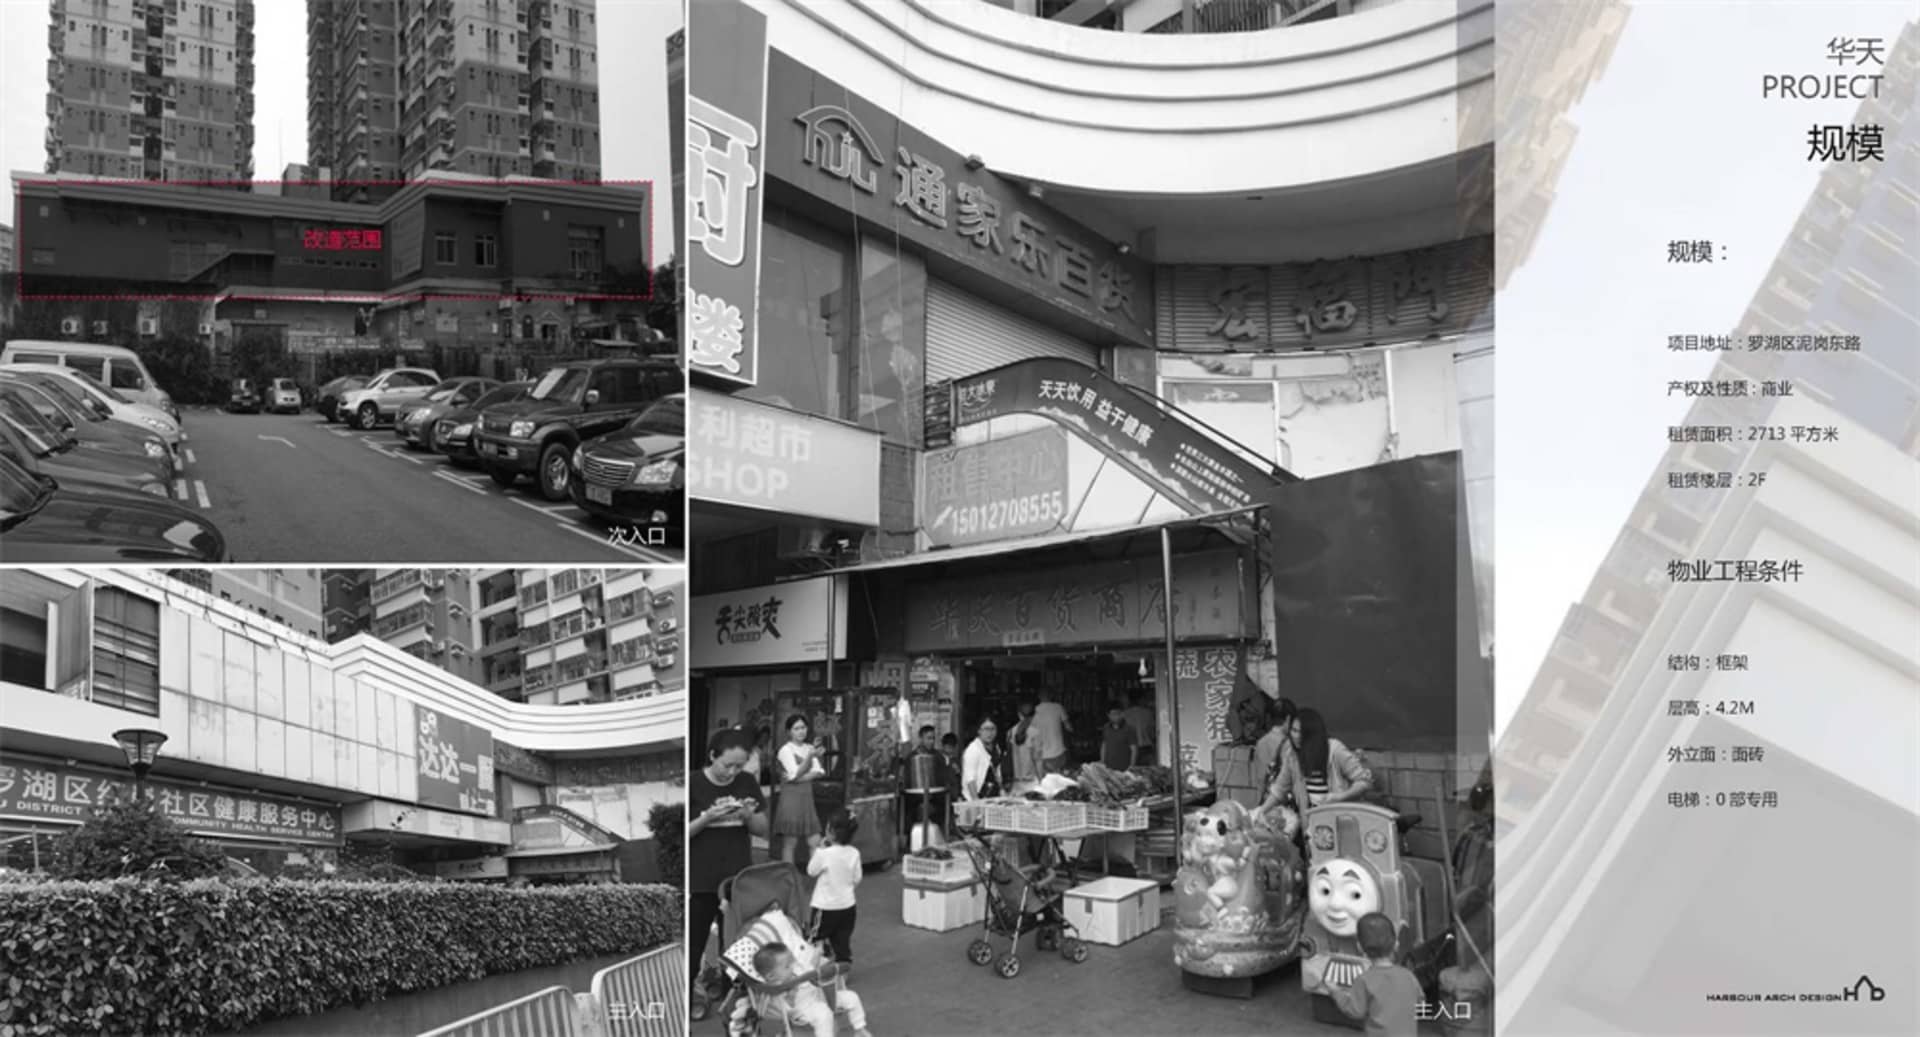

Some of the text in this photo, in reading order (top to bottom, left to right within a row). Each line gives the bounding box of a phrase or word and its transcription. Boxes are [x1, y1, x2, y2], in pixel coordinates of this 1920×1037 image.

[896, 145, 1136, 323] 通家乐百货
[950, 490, 1063, 536] 15012708555
[418, 735, 494, 793] 达达一
[16, 800, 83, 817] DISTRICT
